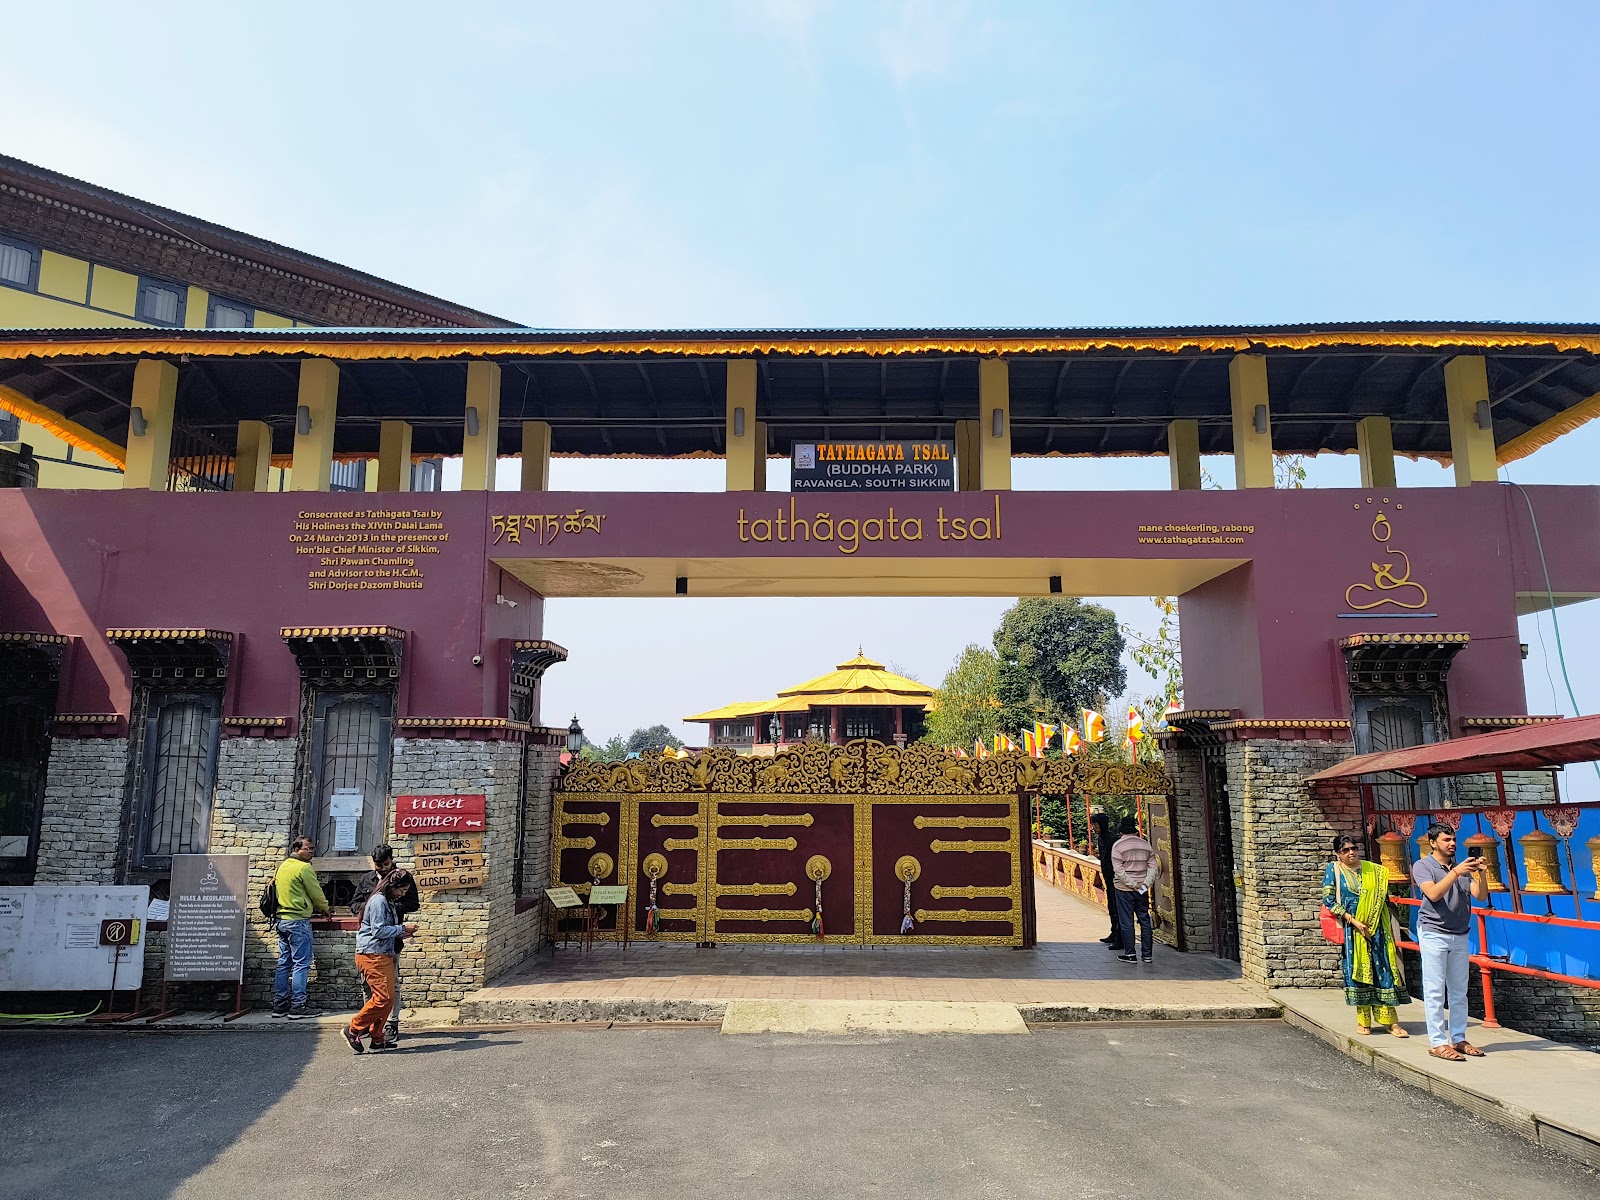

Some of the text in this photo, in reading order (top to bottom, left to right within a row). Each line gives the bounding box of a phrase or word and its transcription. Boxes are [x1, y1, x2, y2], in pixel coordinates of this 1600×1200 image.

[817, 444, 949, 461] TATHAGATA TSAL
[826, 464, 891, 476] (BUDDHA
[896, 464, 938, 476] PARK)
[794, 479, 950, 488] RAVANGLA, SOUTH SIKKIM
[298, 510, 353, 519] Consecrated
[431, 510, 442, 520] by
[936, 495, 1001, 540] tsal
[296, 522, 443, 530] His Holiness the XIVth Dalai Lama
[1164, 524, 1219, 534] choekerling,
[1221, 524, 1254, 534] rabong
[289, 534, 302, 542] On
[303, 534, 315, 542] 24
[316, 534, 344, 542] March
[346, 534, 368, 542] 2013
[397, 535, 437, 543] presence
[439, 533, 449, 541] of
[1138, 535, 1244, 545] www.tathagatatsal.com
[333, 546, 356, 554] Chief
[358, 546, 394, 554] Minister
[407, 545, 440, 554] Sikkim,
[320, 558, 338, 566] Shri
[372, 557, 414, 566] Chamling
[328, 569, 363, 577] Advisor
[308, 580, 423, 590] Shri Dorjee Dazom Bhutia
[411, 798, 465, 809] ticket
[402, 816, 462, 828] counter
[422, 839, 470, 851] NEW HOURS
[423, 858, 444, 867] OPEN
[419, 876, 450, 887] CLOSED
